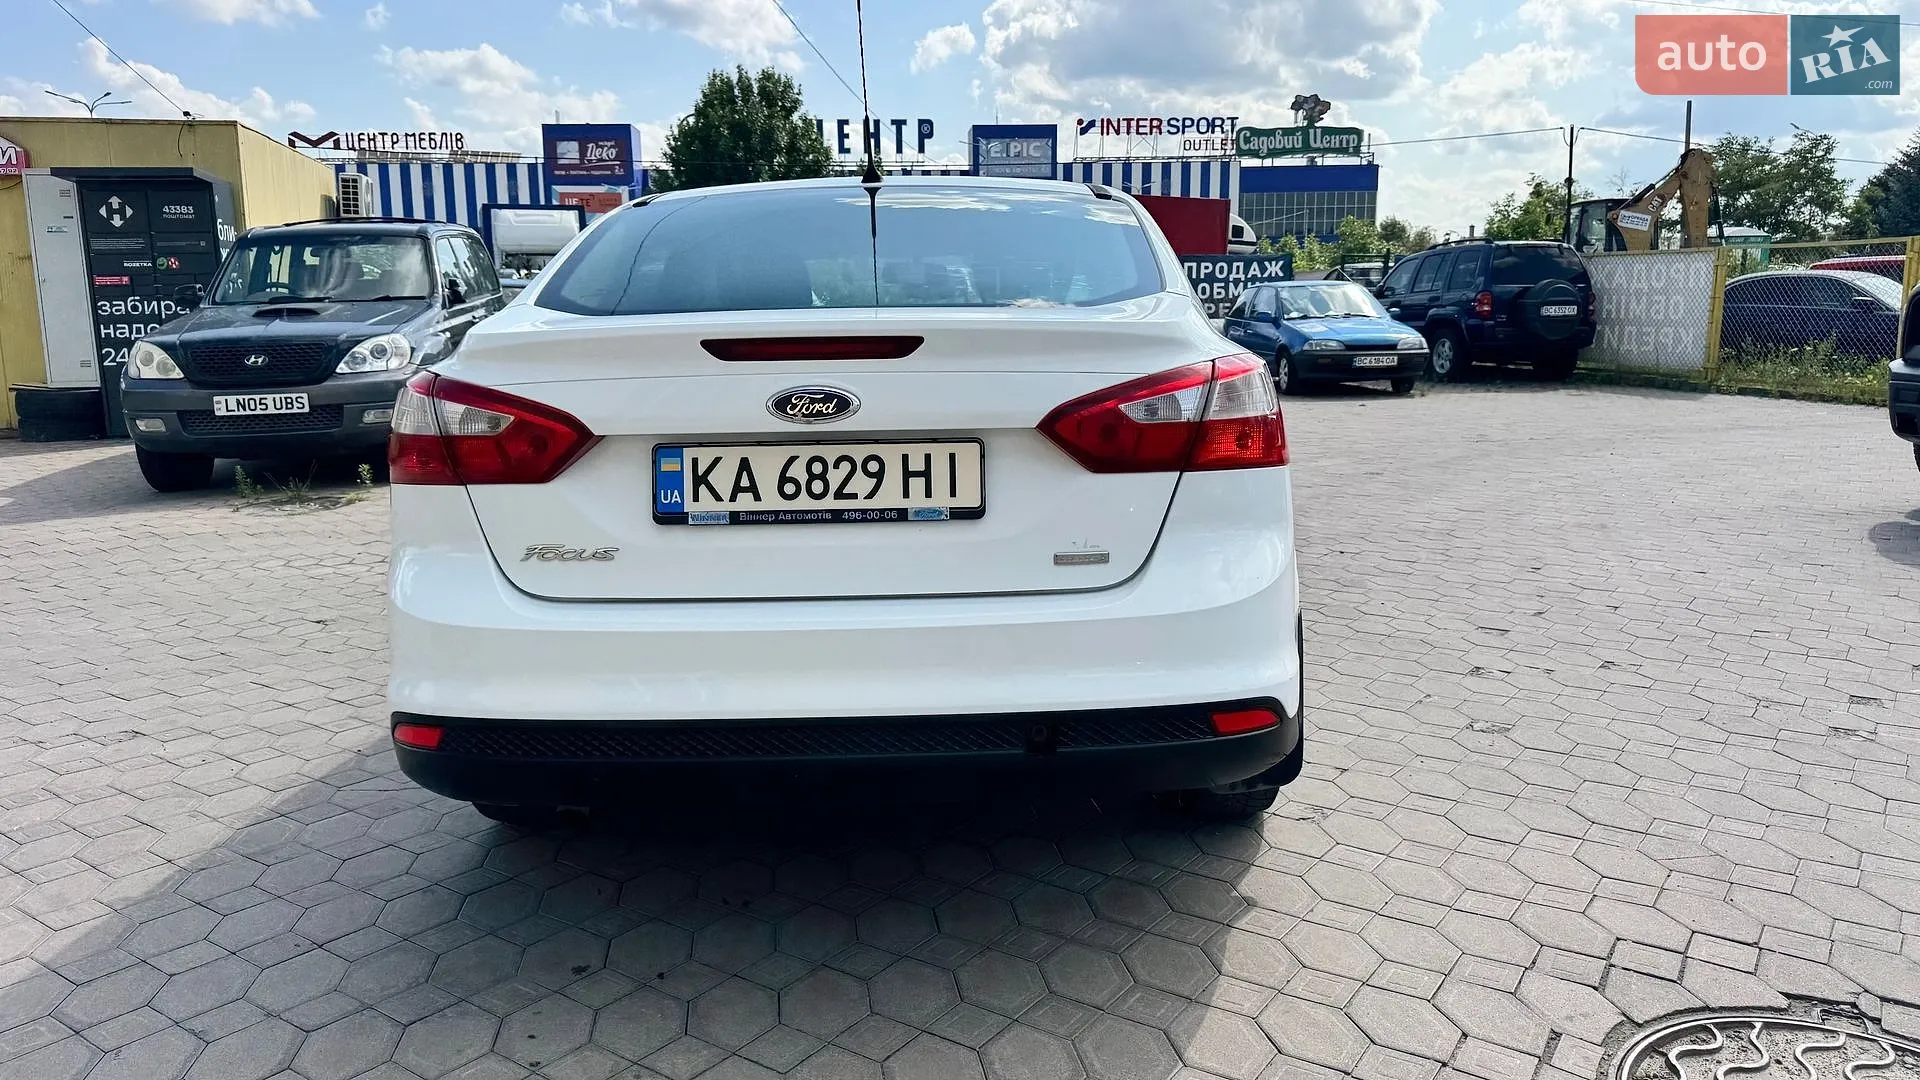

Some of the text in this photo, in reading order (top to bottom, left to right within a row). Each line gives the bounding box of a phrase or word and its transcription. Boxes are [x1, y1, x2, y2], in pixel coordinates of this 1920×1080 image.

[345, 132, 400, 152] ЦЕНТР
[404, 132, 465, 151] МЕБЛІВ
[1183, 139, 1237, 151] OUTLET
[1240, 128, 1358, 157] Садовий Центр
[162, 205, 194, 214] 43383
[1183, 260, 1285, 281] ПРОДАЖ
[225, 398, 268, 412] LN05
[273, 396, 305, 410] UBS
[787, 394, 838, 415] Ford
[691, 452, 956, 502] KA 6829 HI
[661, 490, 681, 504] UA
[842, 511, 898, 519] 496-00-06
[520, 544, 620, 561] Focus
